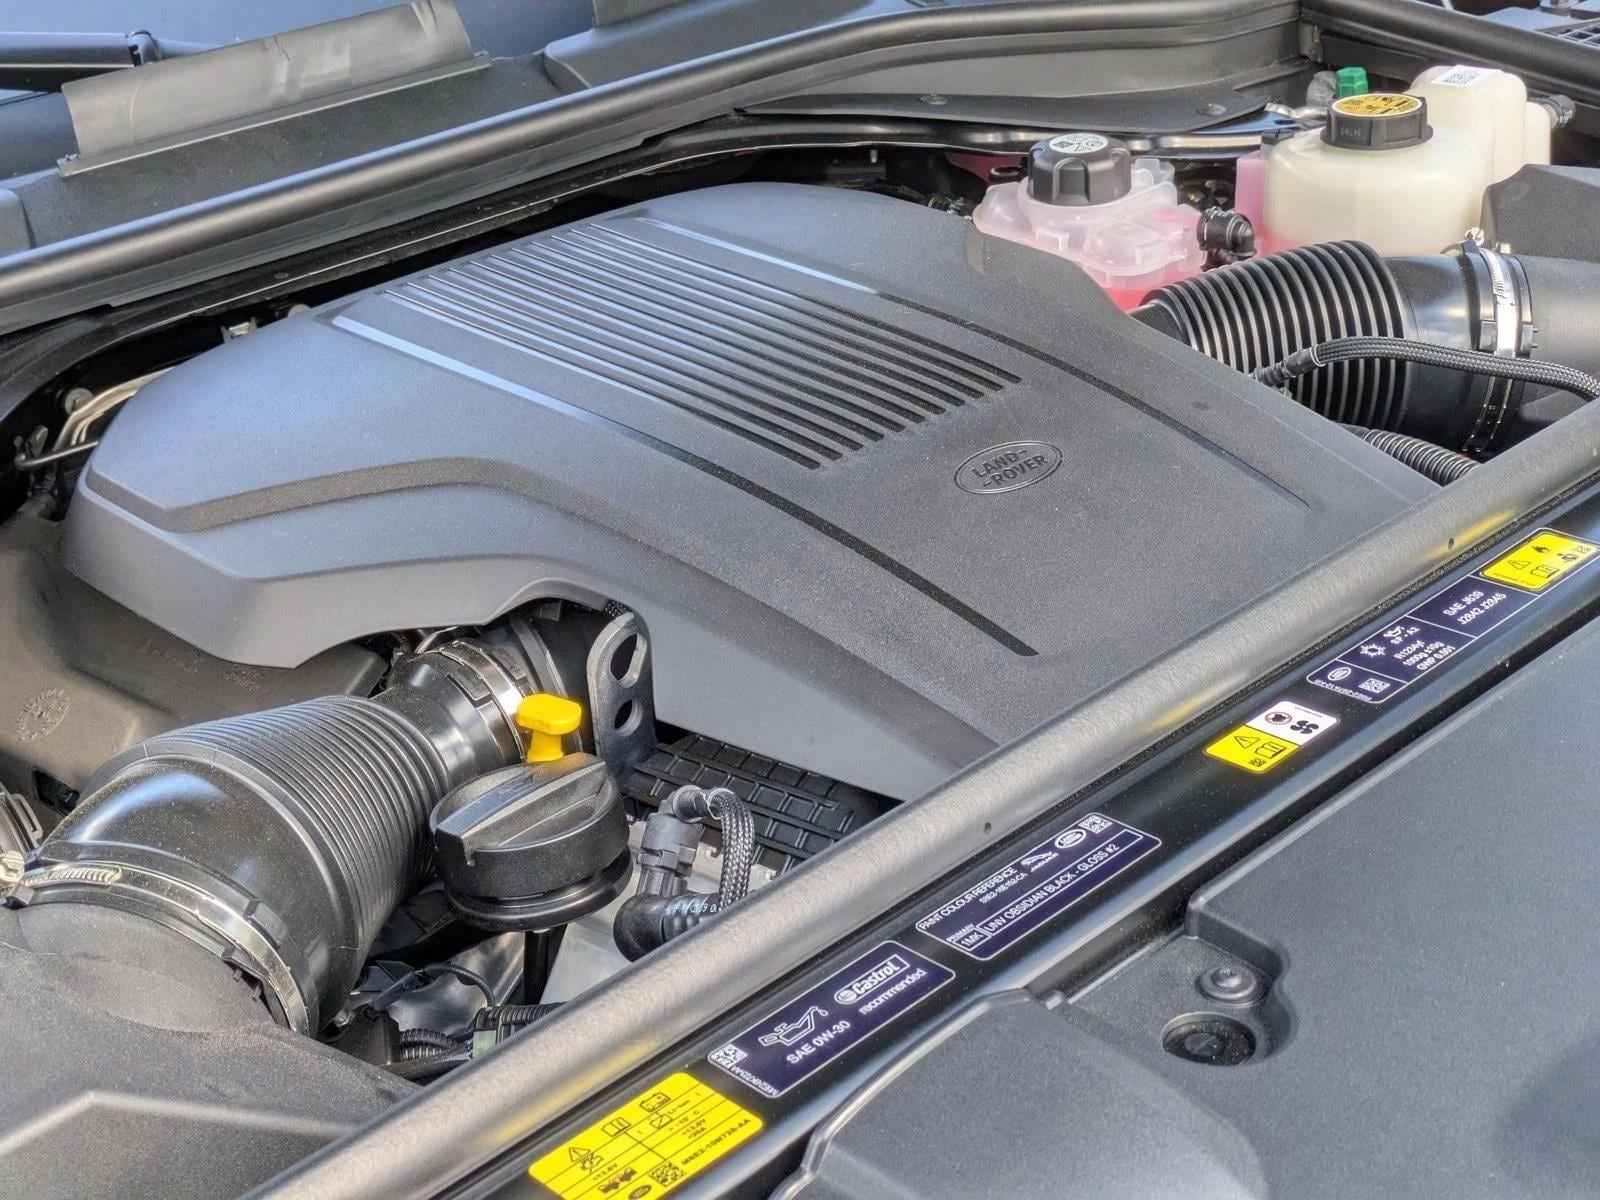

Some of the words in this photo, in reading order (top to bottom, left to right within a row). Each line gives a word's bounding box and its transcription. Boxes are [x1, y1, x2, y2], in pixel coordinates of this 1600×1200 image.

[1443, 601, 1466, 616] SAE
[1462, 591, 1484, 607] J639
[1417, 658, 1437, 670] GWP
[919, 914, 942, 931] PAINT
[941, 893, 975, 917] COLOUR
[972, 866, 1018, 899] REFERENCE
[984, 916, 1007, 933] UNV
[1004, 890, 1046, 919] OBSIDIAN
[1045, 872, 1077, 894] BLACK
[1077, 852, 1107, 877] GLOSS
[1105, 843, 1119, 857] #2
[947, 923, 976, 942] PRIMARY
[961, 932, 984, 947] 1MK
[851, 961, 900, 995] Castrol
[859, 968, 928, 1015] recommended
[786, 1041, 813, 1065] SAE
[814, 1020, 851, 1047] 0W-30
